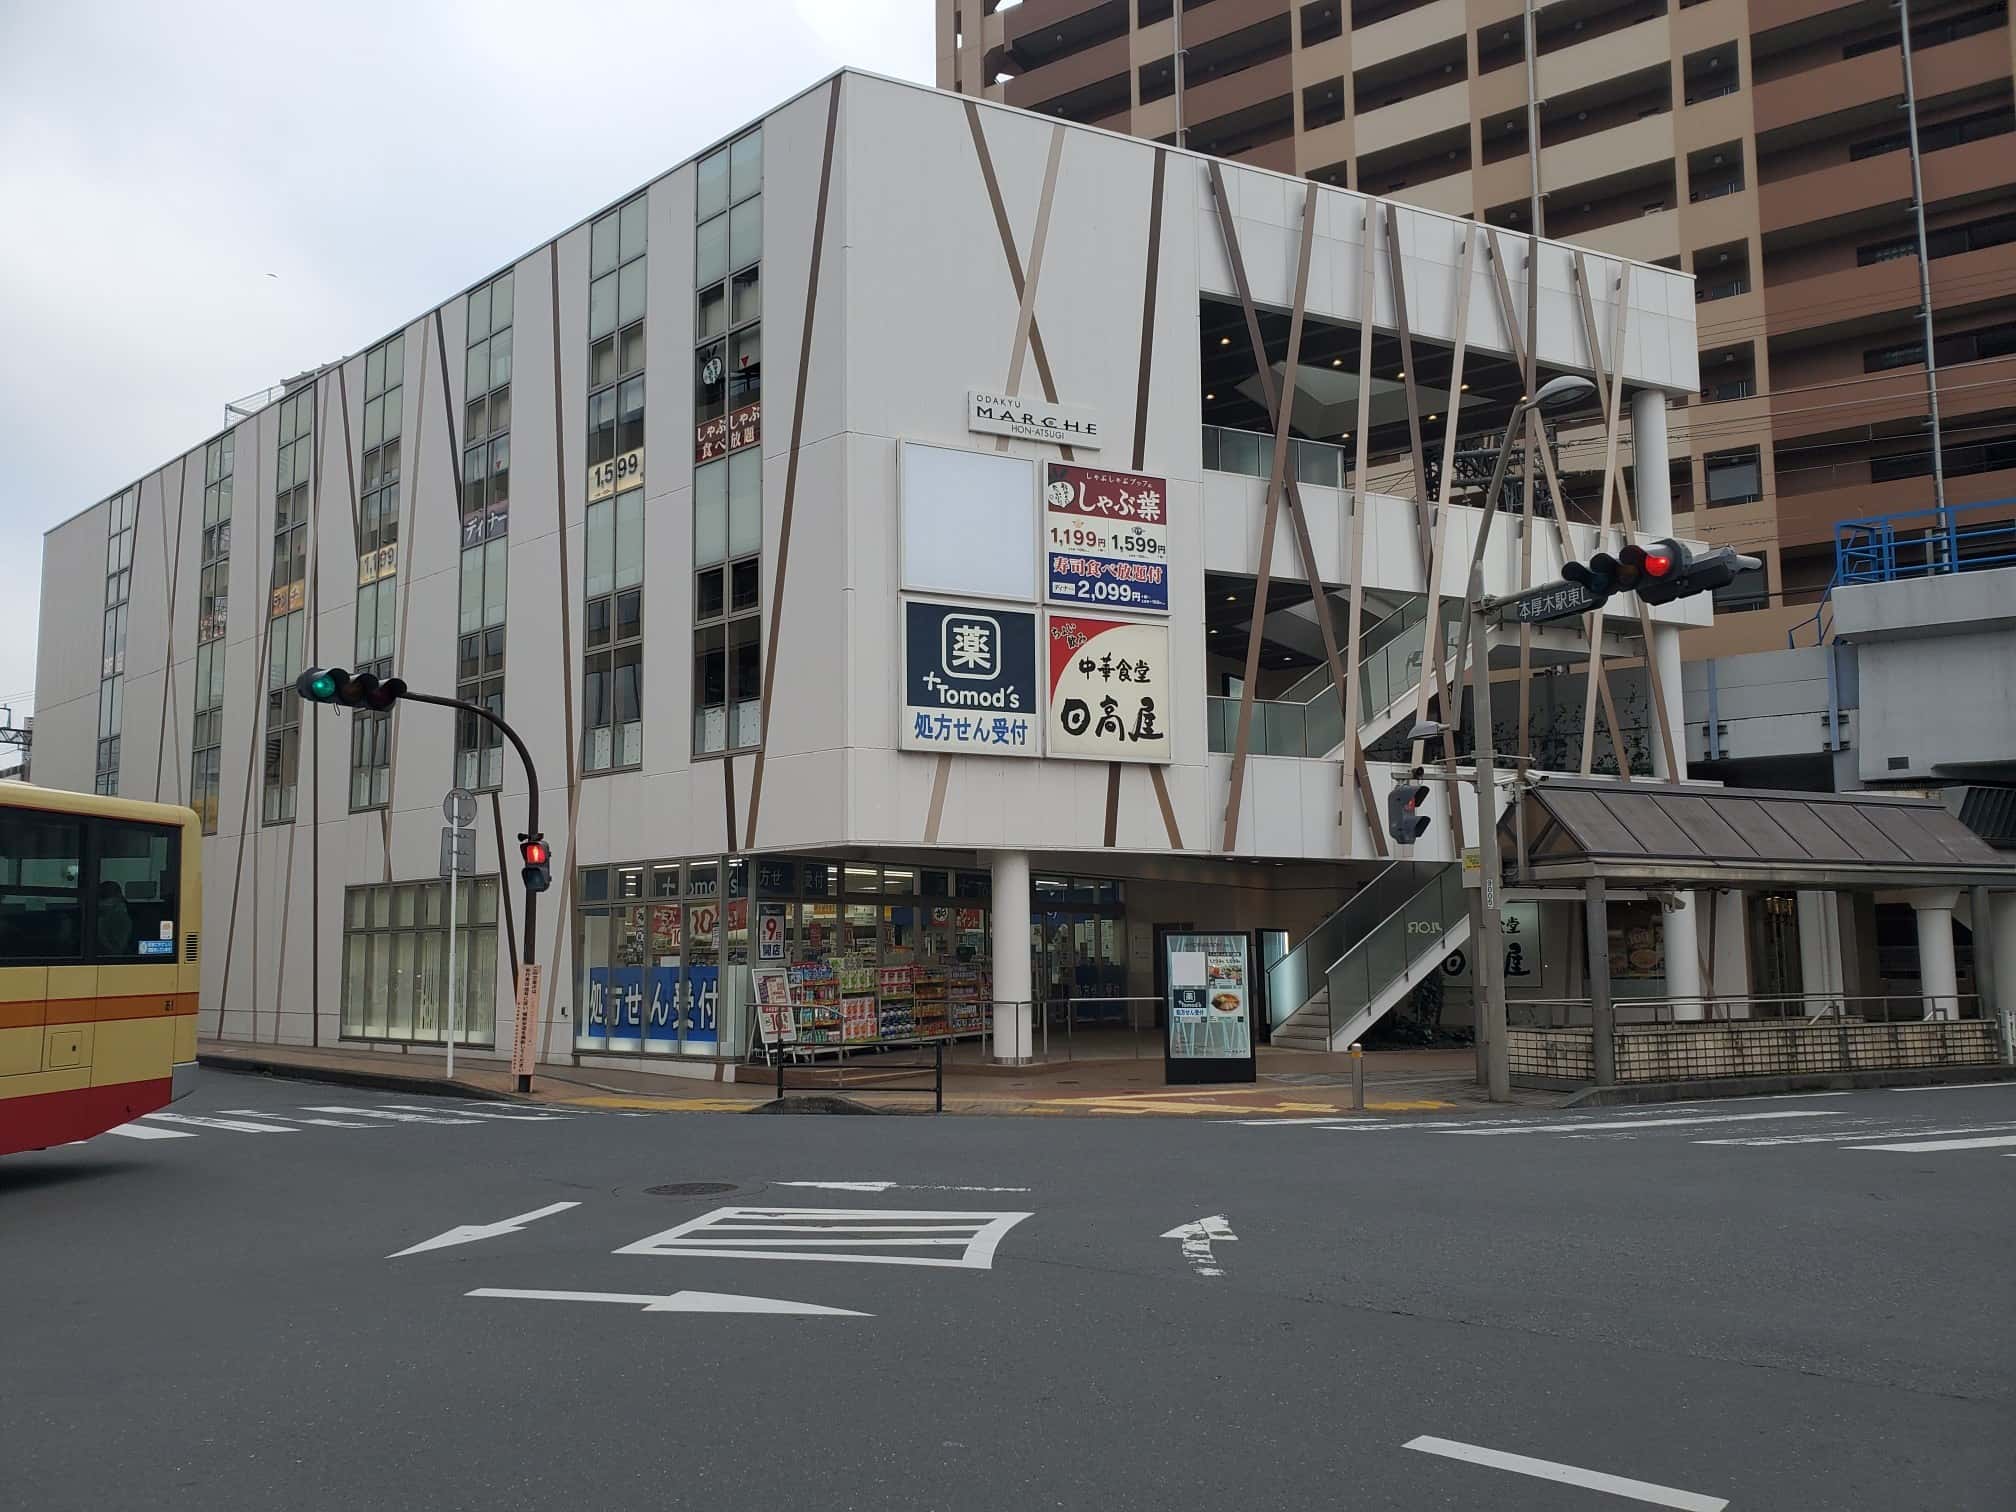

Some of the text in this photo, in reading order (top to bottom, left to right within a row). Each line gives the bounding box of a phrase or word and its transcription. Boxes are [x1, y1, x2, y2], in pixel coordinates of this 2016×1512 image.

[976, 394, 1021, 409] ODAKYU
[976, 405, 1097, 436] MARCHE
[1011, 424, 1065, 440] HON-ATSUGI
[1078, 481, 1161, 521] しゃぶ葉
[466, 512, 507, 542] ディナー
[1053, 557, 1163, 584] 寿司食べ放題付
[1078, 580, 1141, 603] 2,099円
[952, 624, 992, 670] 薬
[1079, 652, 1151, 683] 中華食堂
[937, 683, 1020, 709] Tomod's
[914, 712, 1028, 746] 処方せん受付
[1061, 695, 1164, 742] 日高屋
[589, 978, 719, 1030] 処方せん受付
